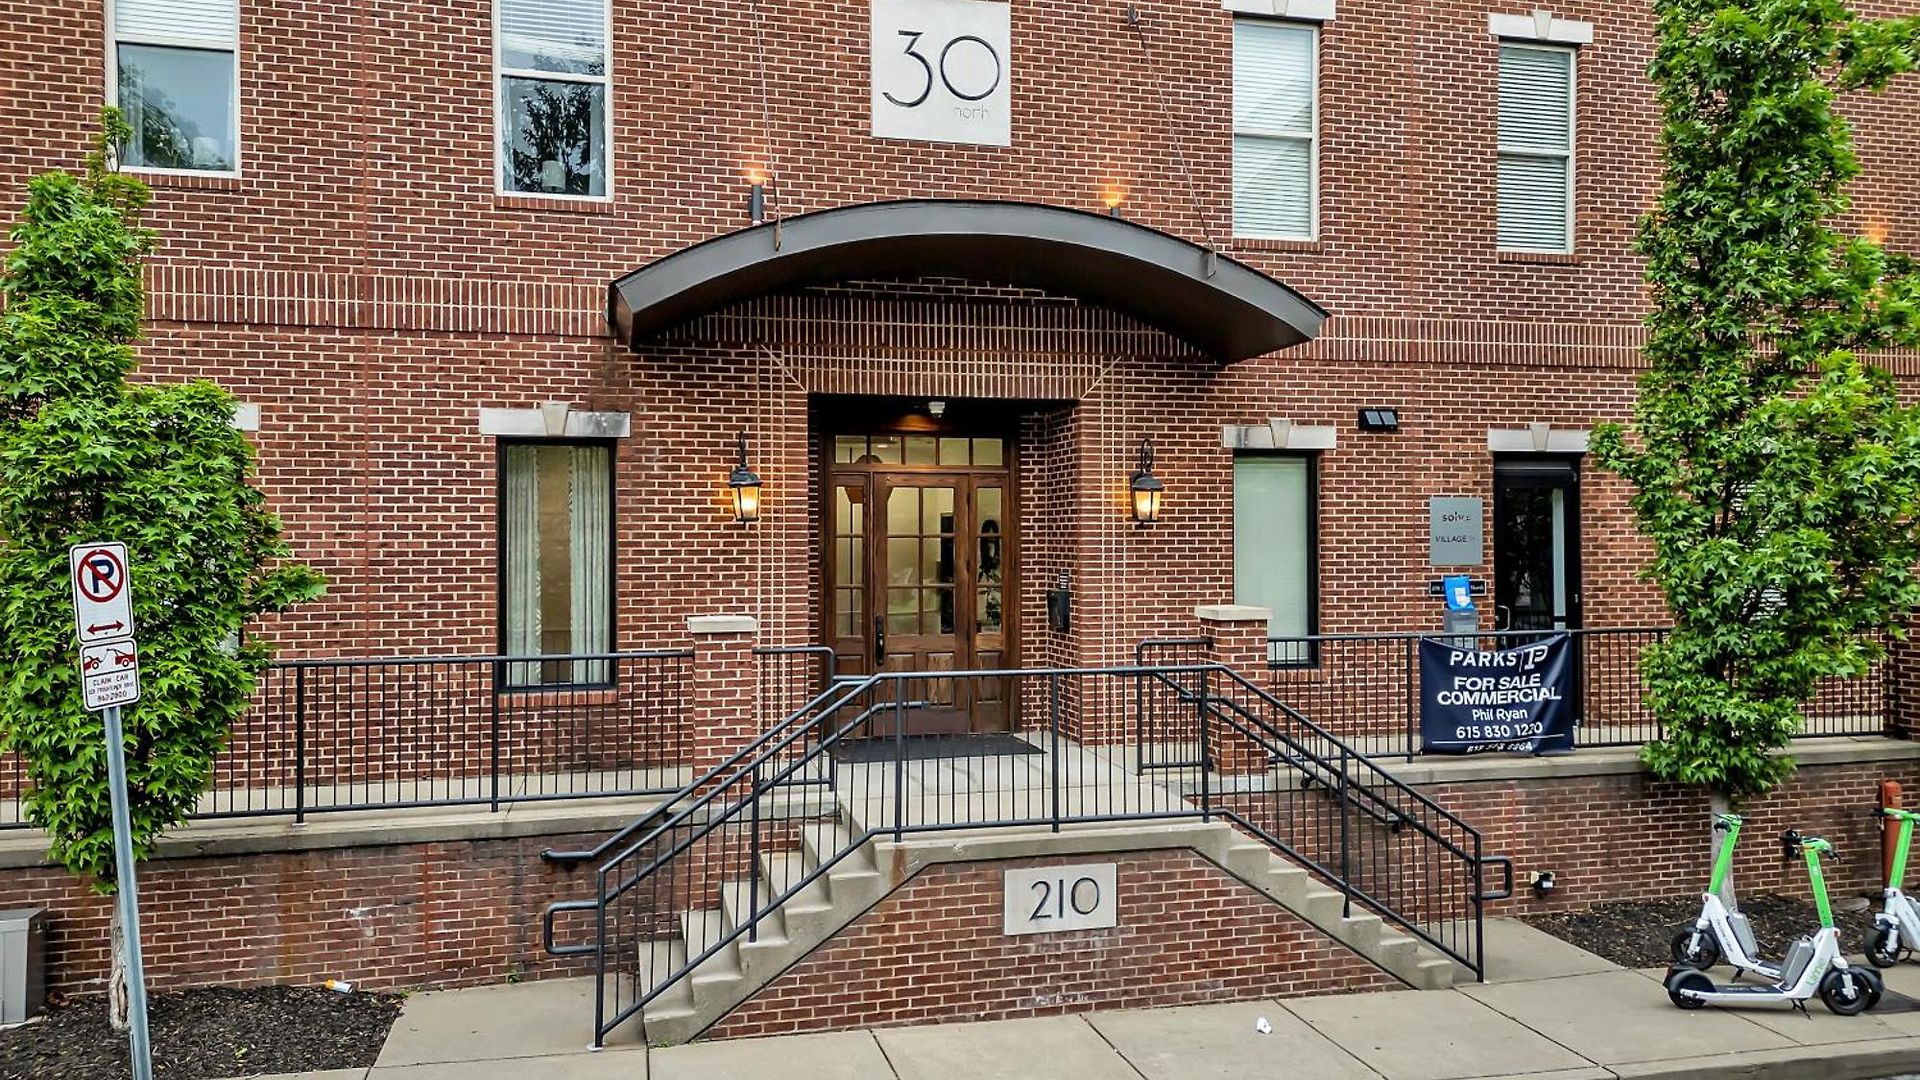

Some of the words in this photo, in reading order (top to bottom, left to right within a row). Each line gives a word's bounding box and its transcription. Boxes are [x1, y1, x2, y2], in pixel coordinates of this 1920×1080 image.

[882, 30, 1000, 108] 30
[1449, 650, 1517, 667] PARKS
[1453, 676, 1496, 691] FOR
[1498, 673, 1541, 690] SALE
[1437, 686, 1562, 706] COMMERCIAL
[1472, 708, 1494, 721] Phil
[1496, 708, 1528, 722] Ryan
[1456, 726, 1481, 739] 615
[1484, 724, 1510, 738] 830
[1514, 721, 1543, 736] 1220
[1029, 877, 1100, 921] 210
